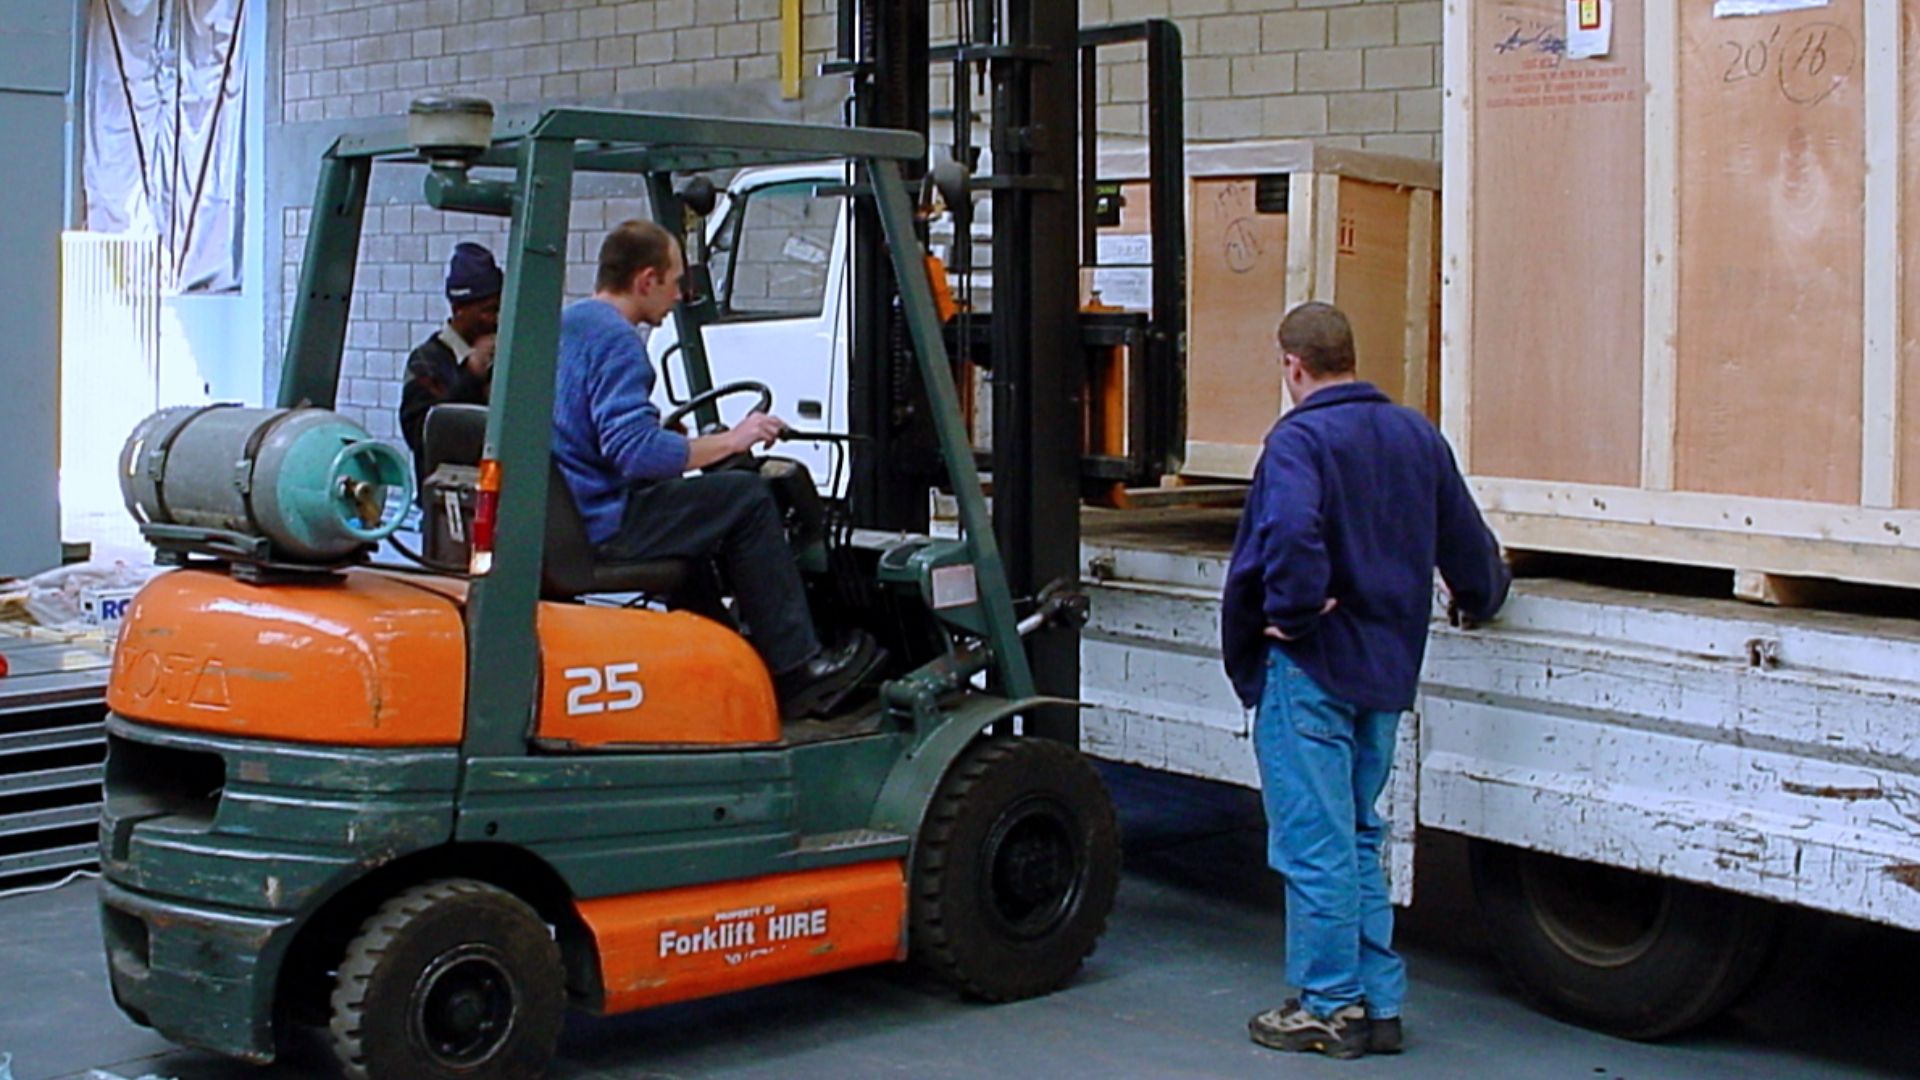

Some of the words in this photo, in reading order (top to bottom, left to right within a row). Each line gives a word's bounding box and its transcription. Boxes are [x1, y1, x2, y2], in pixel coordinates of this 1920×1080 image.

[564, 662, 644, 716] 25
[659, 921, 756, 959] Forklift
[768, 908, 828, 942] HIRE
